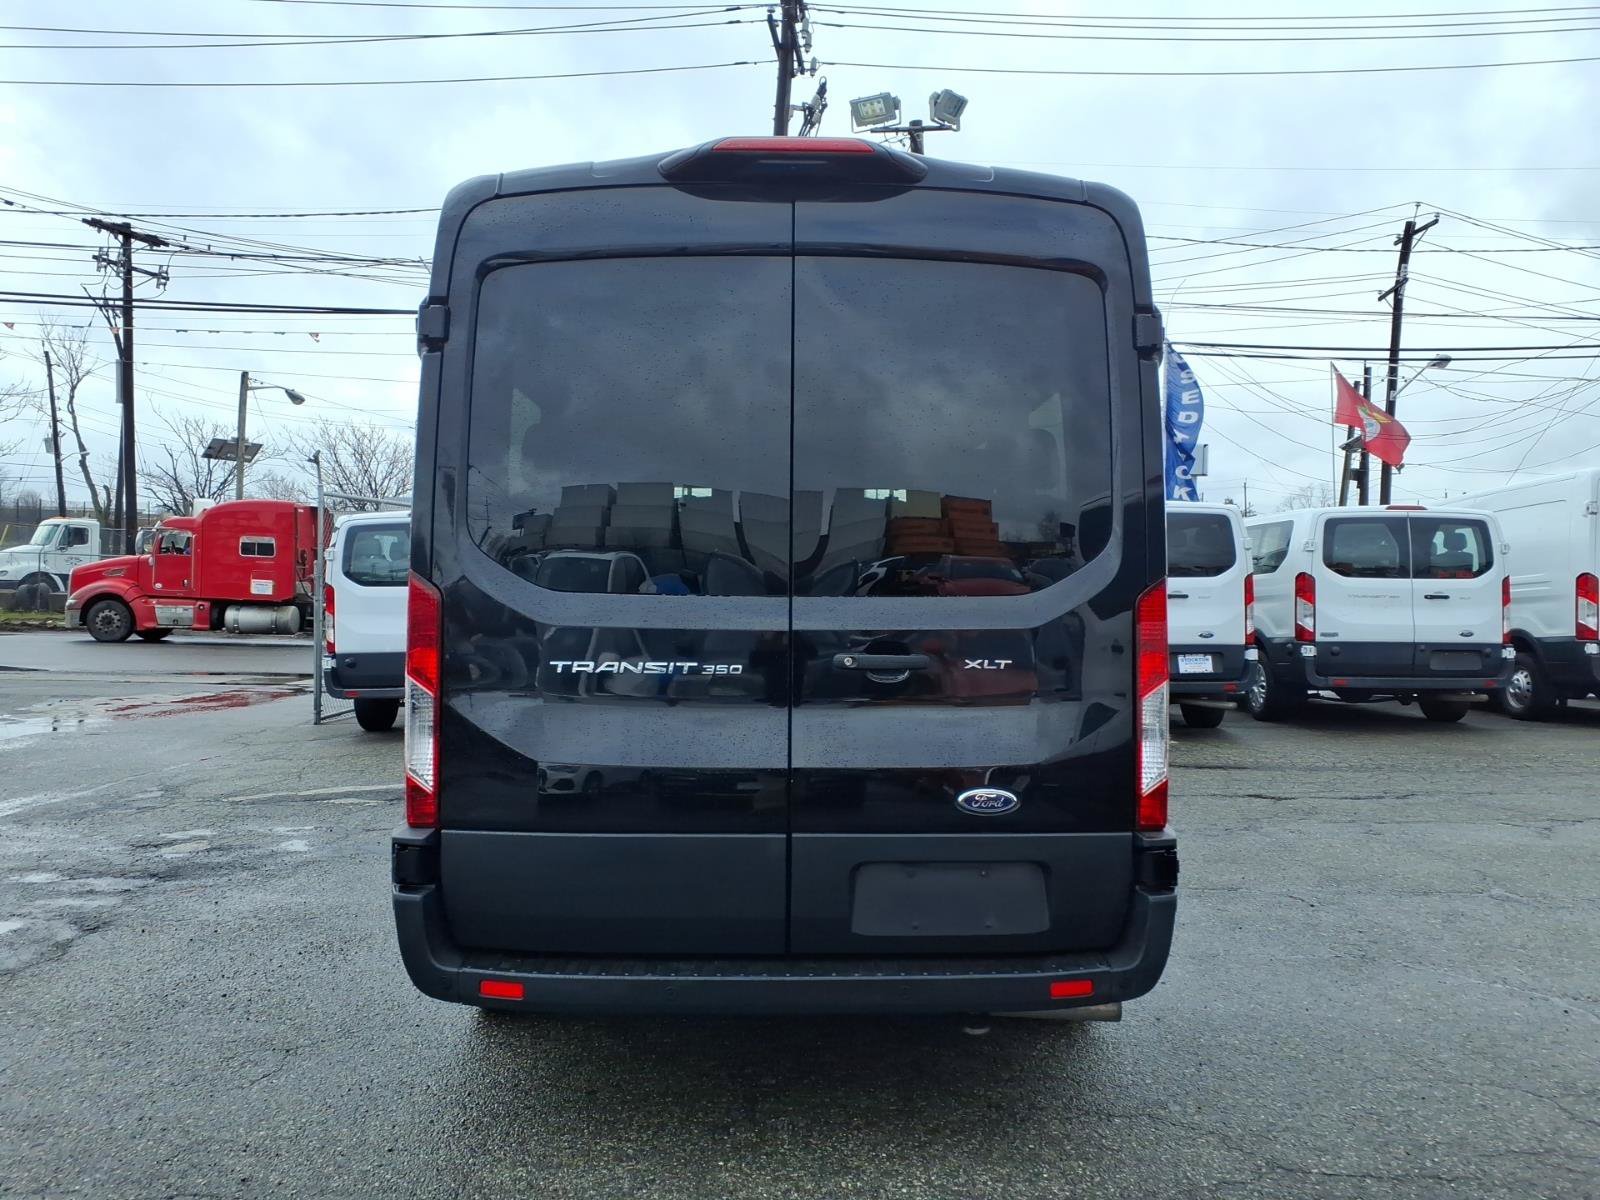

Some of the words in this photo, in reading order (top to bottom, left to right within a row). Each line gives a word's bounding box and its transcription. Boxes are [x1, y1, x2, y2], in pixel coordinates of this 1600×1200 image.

[549, 661, 698, 674] TRANSIT
[701, 664, 743, 675] 350
[964, 659, 1013, 670] XLT
